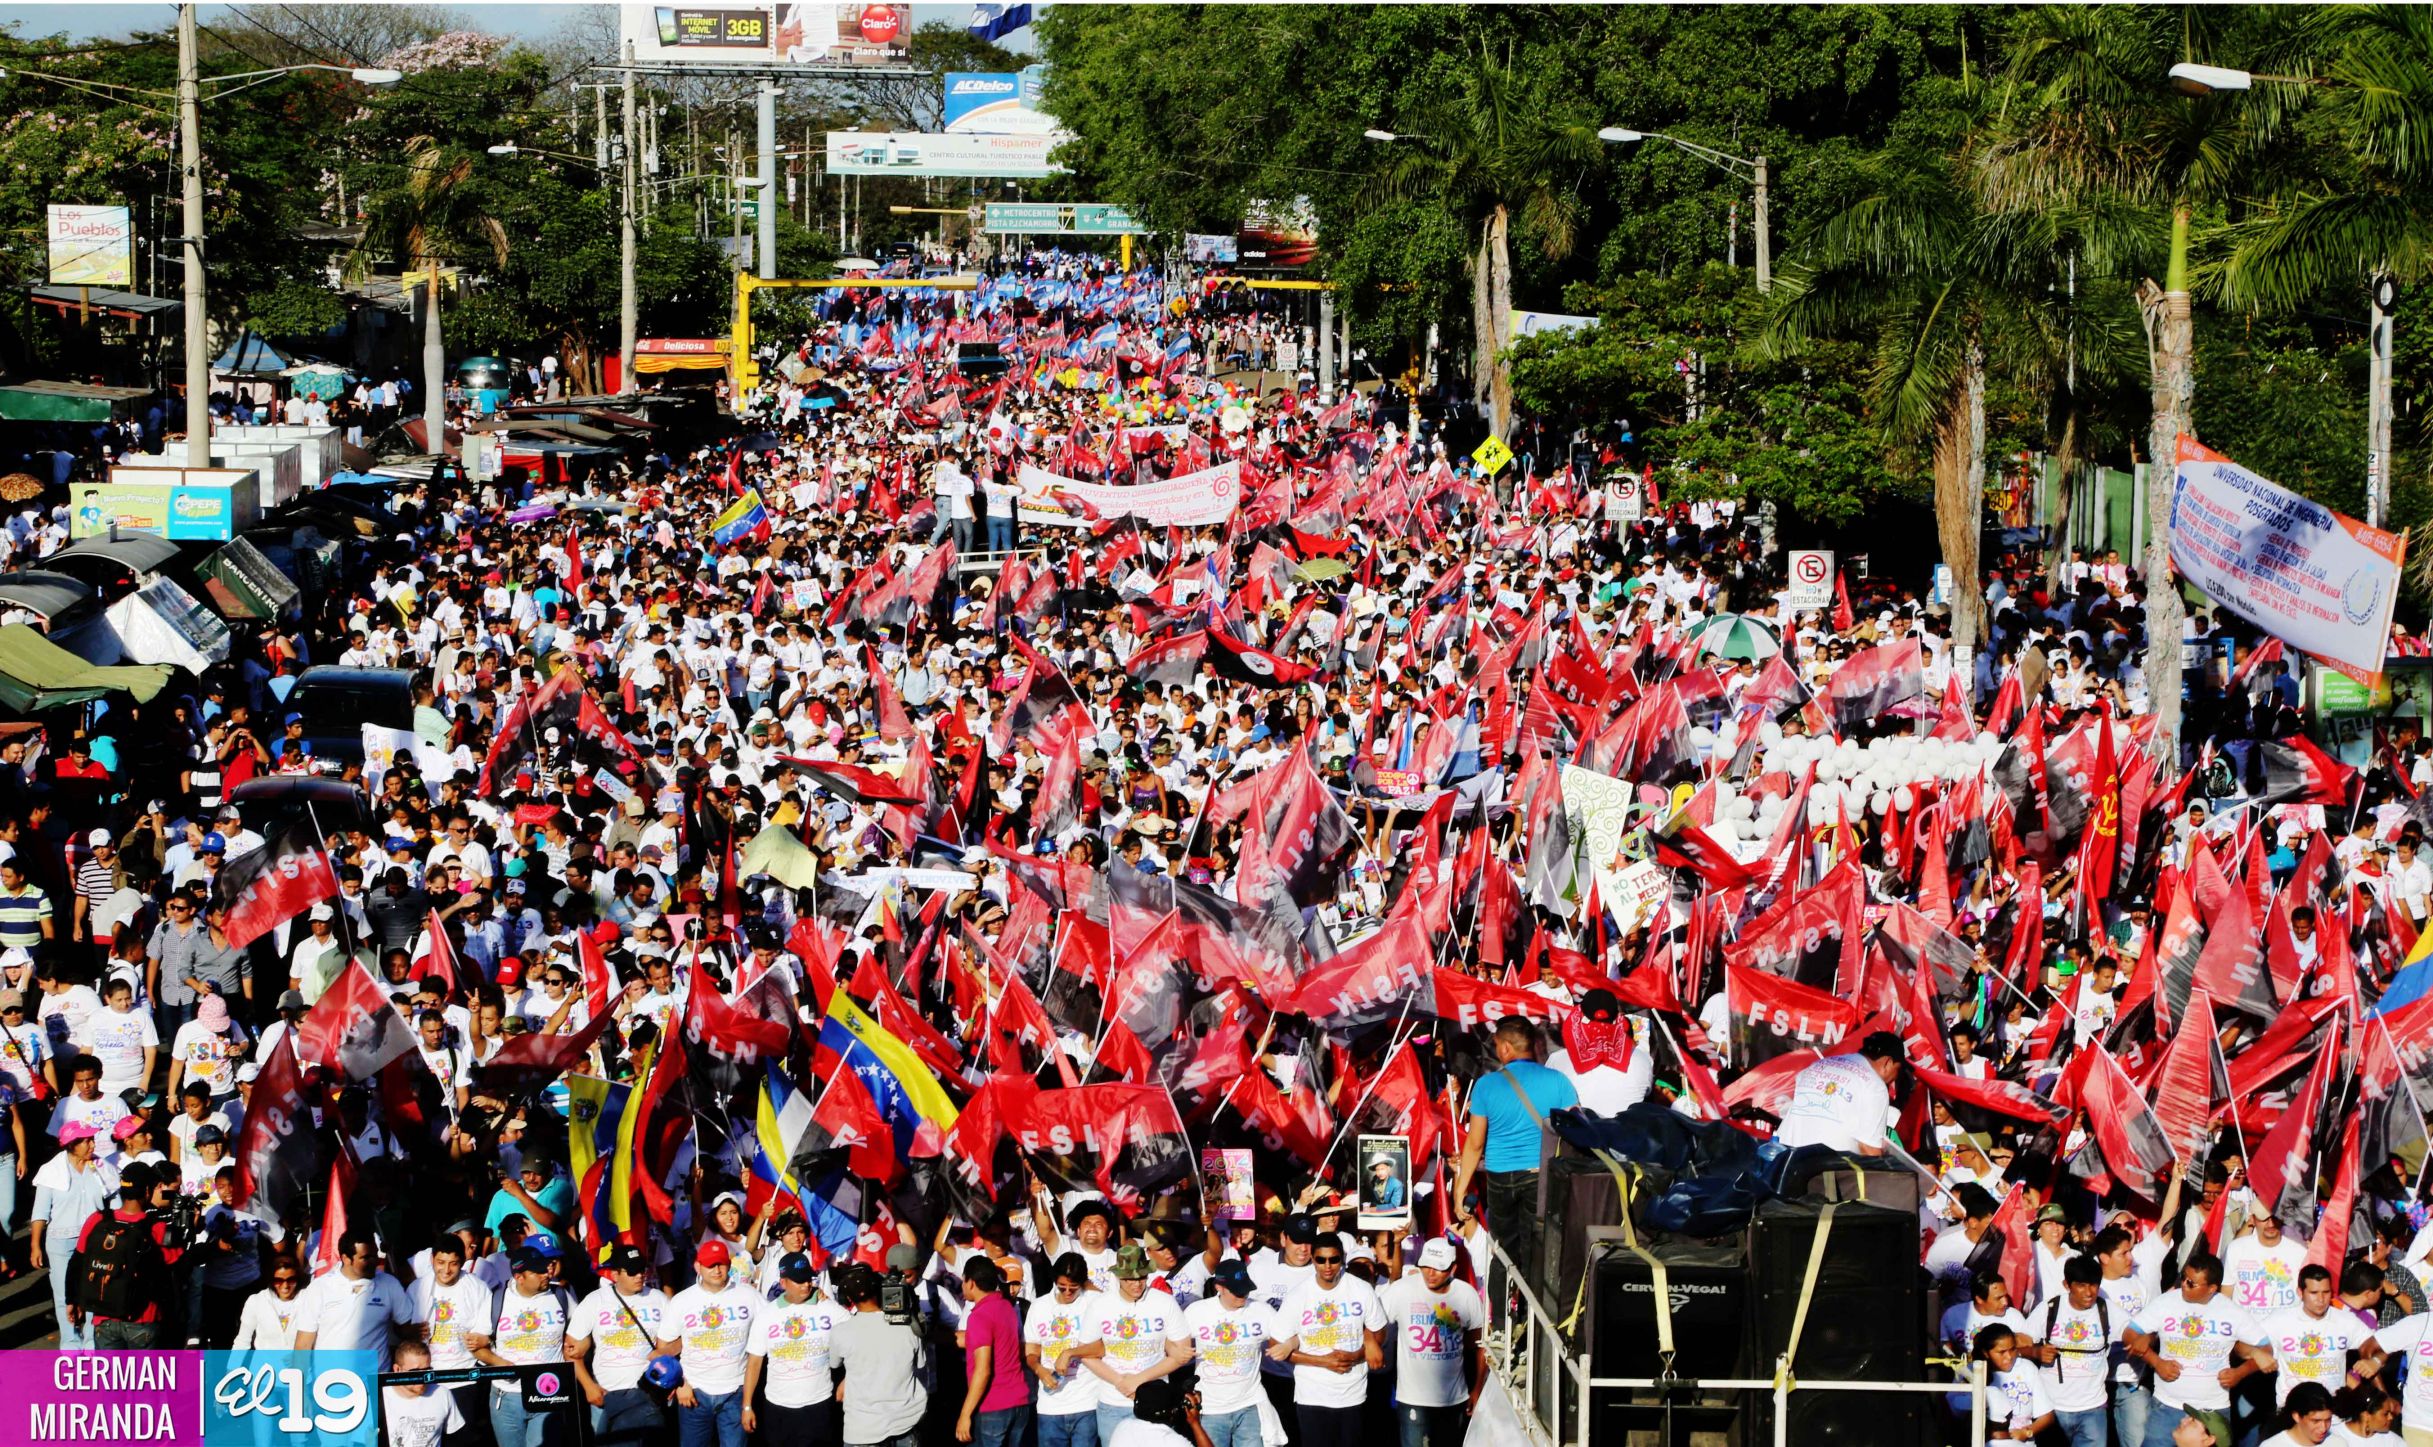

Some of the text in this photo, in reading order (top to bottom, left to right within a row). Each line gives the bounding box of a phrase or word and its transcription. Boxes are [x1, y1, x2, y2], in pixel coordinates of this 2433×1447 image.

[728, 19, 762, 36] 3GB
[862, 17, 892, 29] Claro
[688, 26, 711, 34] MÓVIL
[853, 47, 906, 58] Claro que sí
[953, 80, 1014, 92] ACDelco
[58, 208, 81, 220] Los
[1004, 209, 1057, 218] METROCENTRO
[58, 222, 121, 236] Pueblos
[987, 219, 1008, 228] PISTA
[1244, 250, 1267, 258] adidas
[664, 341, 705, 351] Deliciosa
[2213, 464, 2254, 493] UNIVERSIDAD
[2251, 484, 2286, 510] NACIONAL
[2283, 499, 2296, 515] DE
[2293, 504, 2334, 534] INGENIERIA
[1023, 501, 1068, 514] JUVENTU
[2243, 500, 2294, 533] POSGRADOS
[1792, 595, 1830, 605] ESTACIONAR
[1612, 868, 1662, 893] NO TERR
[1620, 880, 1669, 906] AL MEDIA
[1746, 1001, 1847, 1045] FSLN
[1021, 1123, 1100, 1156] FSL
[1203, 1155, 1250, 1171] 2014
[92, 1260, 114, 1271] LiveU
[2238, 1281, 2268, 1307] 34
[1408, 1326, 1442, 1353] 34
